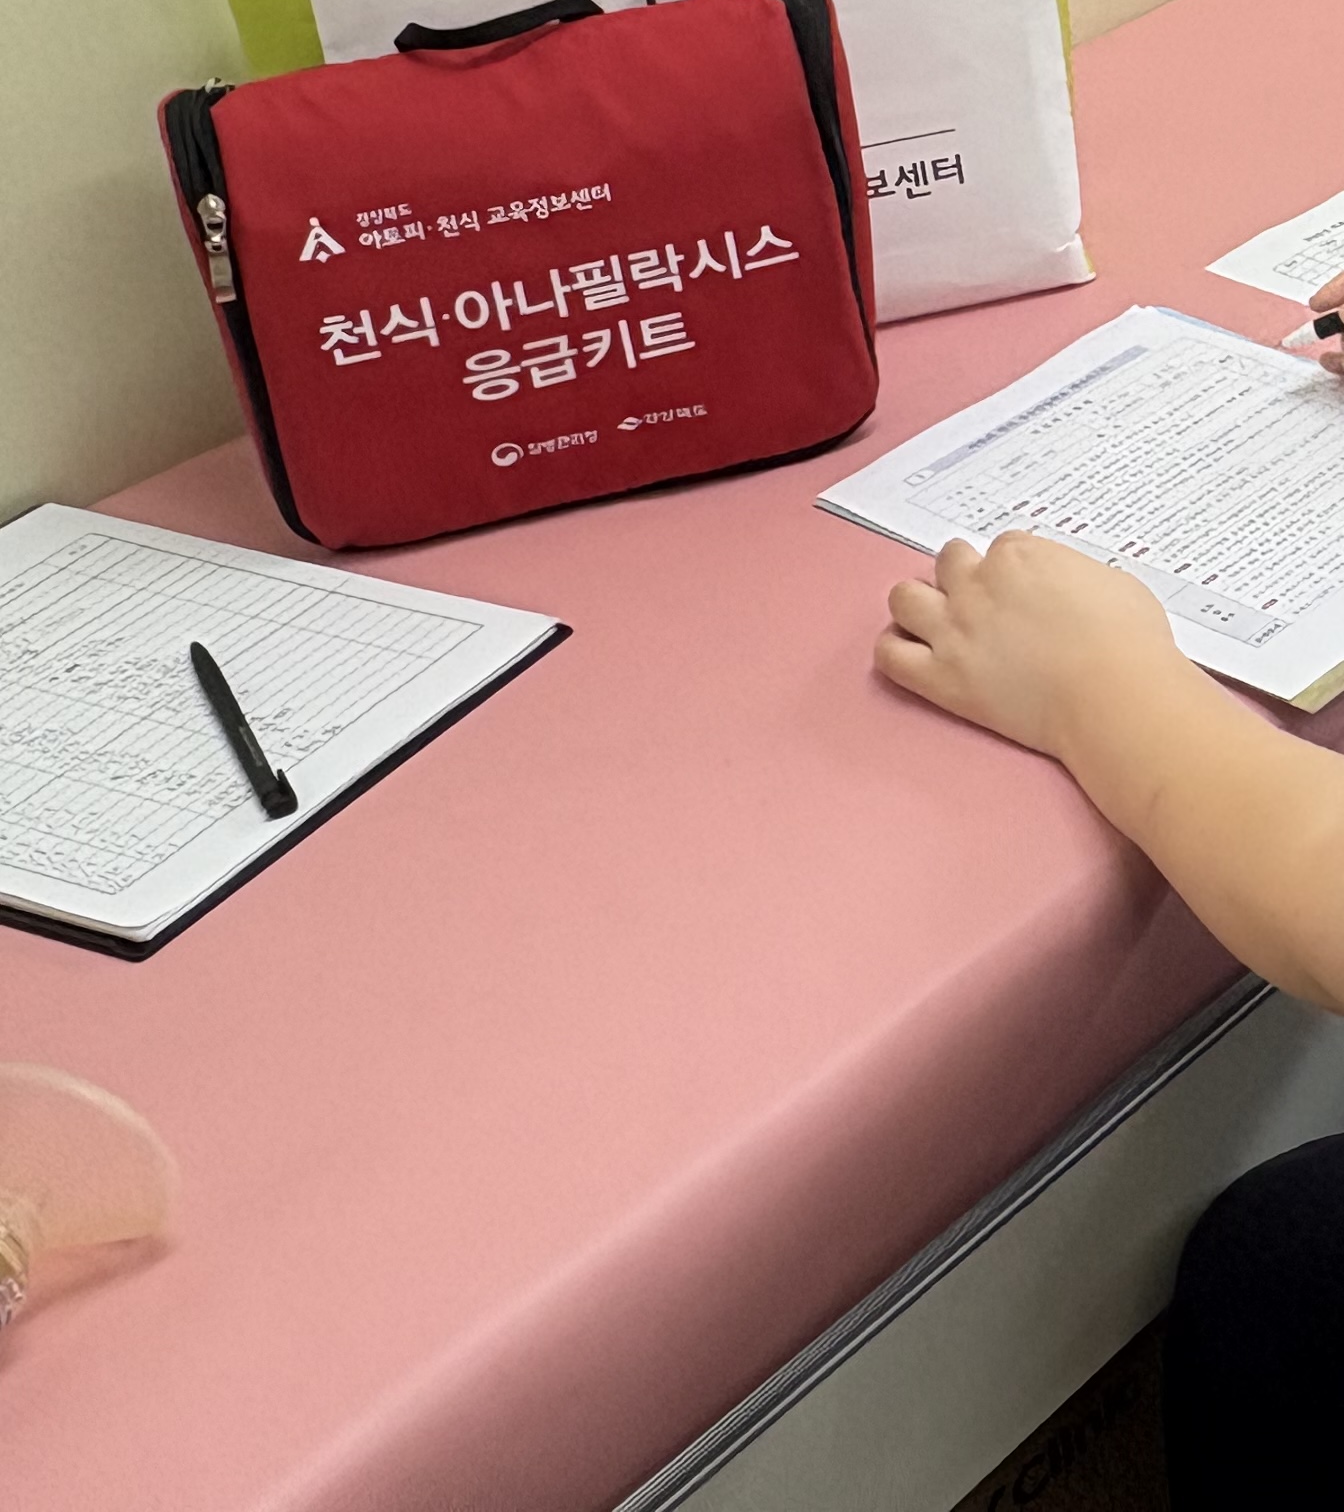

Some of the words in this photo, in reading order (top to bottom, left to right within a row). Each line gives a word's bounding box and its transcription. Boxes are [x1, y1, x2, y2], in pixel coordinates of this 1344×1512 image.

[486, 182, 612, 225] 교육정보센터
[319, 225, 800, 366] 천식·아나필락시스
[462, 311, 696, 401] 응급키트
